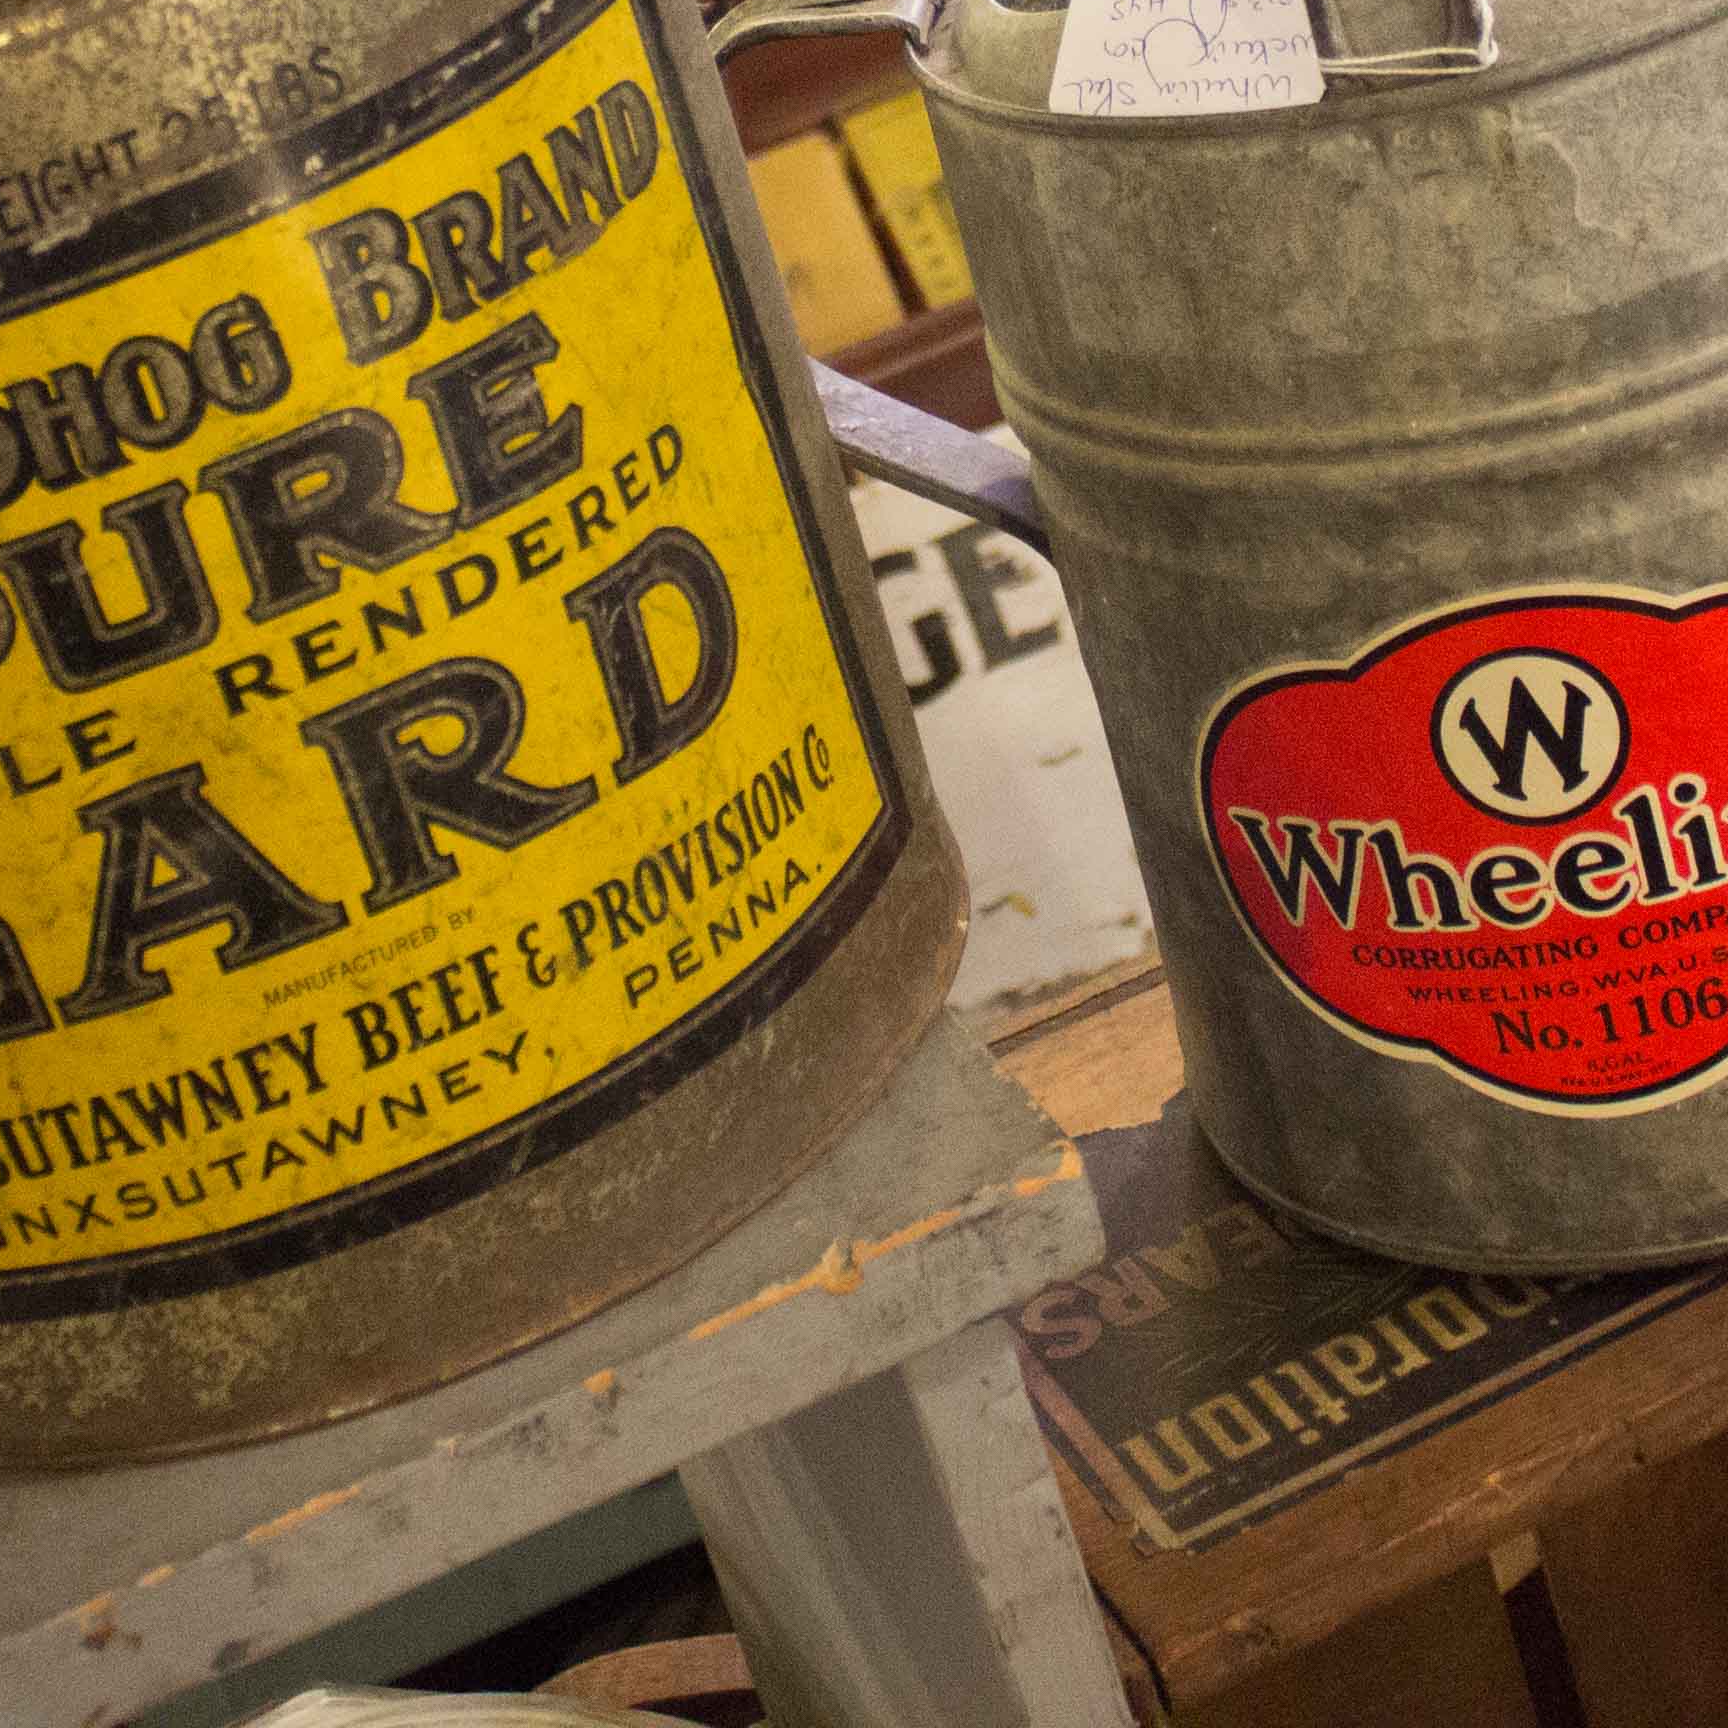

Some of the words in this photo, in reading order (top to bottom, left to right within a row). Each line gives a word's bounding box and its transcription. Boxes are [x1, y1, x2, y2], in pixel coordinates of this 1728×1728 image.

[303, 78, 661, 368] BRAND
[211, 422, 685, 719] RENDERED
[1458, 675, 1593, 801] W
[260, 924, 439, 1011] MANUFACTURED
[447, 905, 477, 933] BY
[343, 942, 506, 1073] BEEF
[515, 920, 558, 990] &
[557, 747, 809, 971] PROVISION
[622, 857, 824, 1010] PENNA.
[1351, 934, 1599, 972] CORRUGATING
[1490, 1007, 1582, 1054] No.
